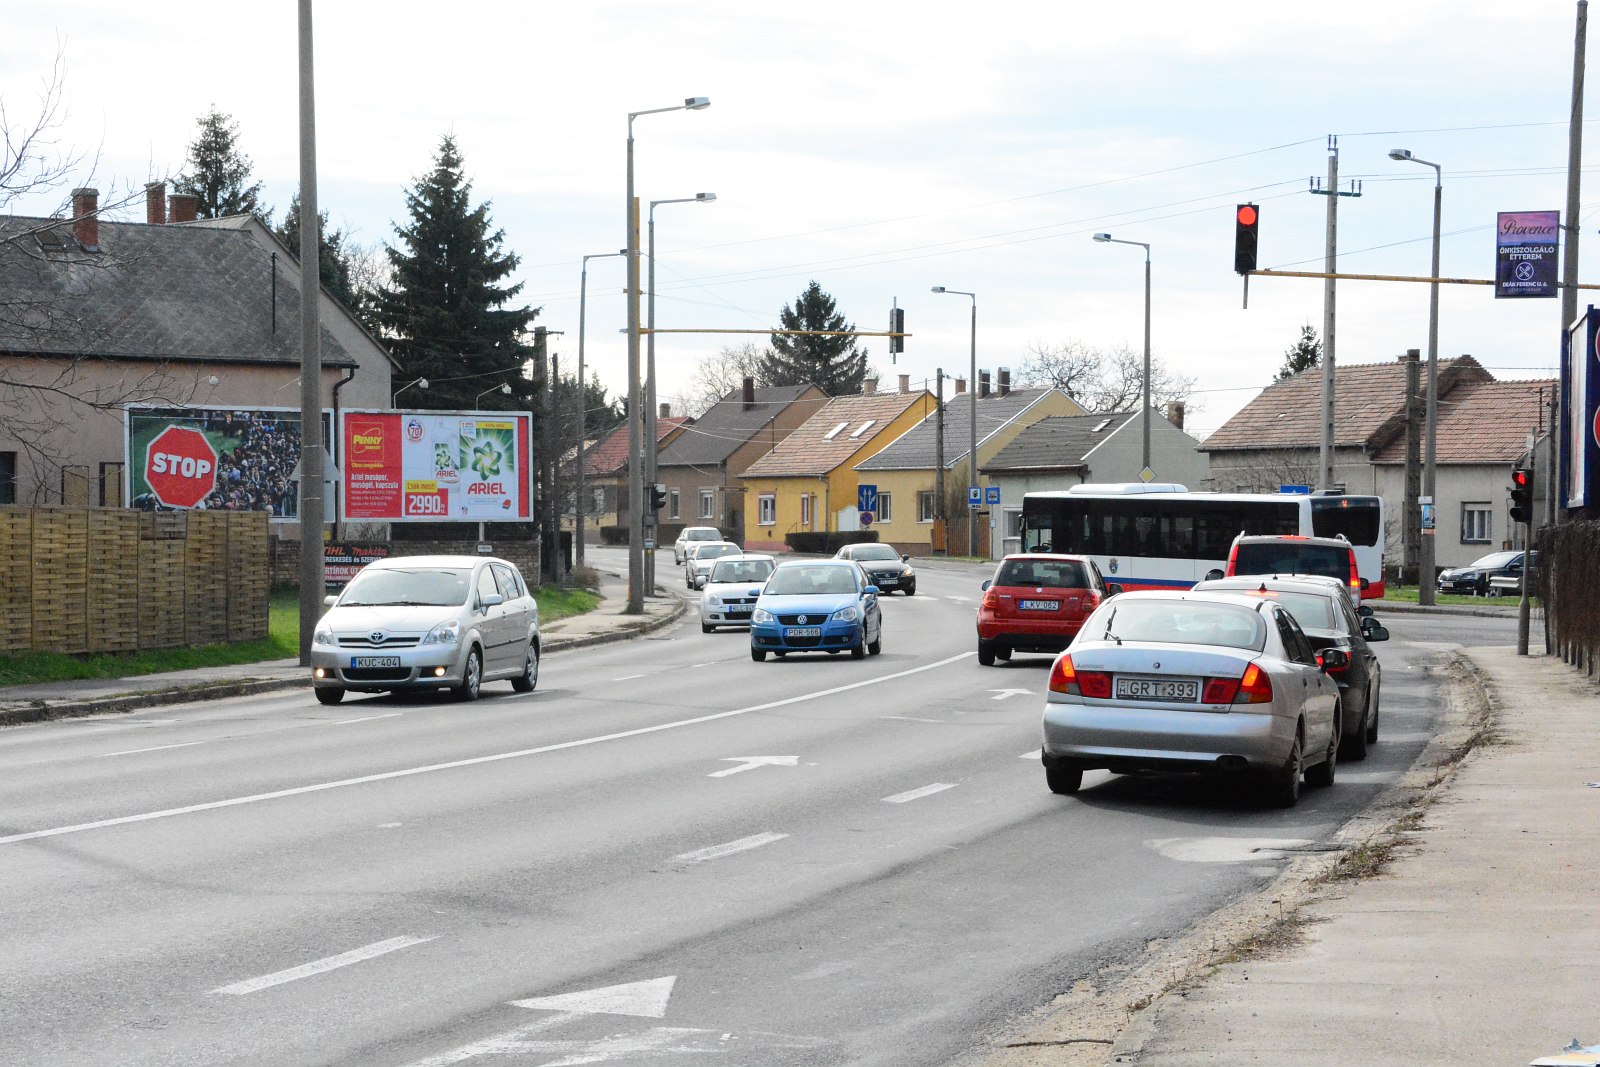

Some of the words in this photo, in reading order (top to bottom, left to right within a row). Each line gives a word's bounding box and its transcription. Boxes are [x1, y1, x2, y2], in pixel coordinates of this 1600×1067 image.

[1500, 219, 1555, 235] Provence
[1500, 246, 1555, 254] ÖNKISZOLGÁLÓ
[353, 435, 383, 445] PENNY
[151, 452, 211, 479] STOP
[436, 470, 458, 478] ARIEL
[467, 482, 507, 495] ARIEL
[408, 495, 441, 513] 2990
[324, 546, 345, 556] TIHL
[324, 555, 352, 563] ERESKEDÉS
[325, 566, 348, 575] RTÍROK
[357, 657, 398, 668] KUC-404
